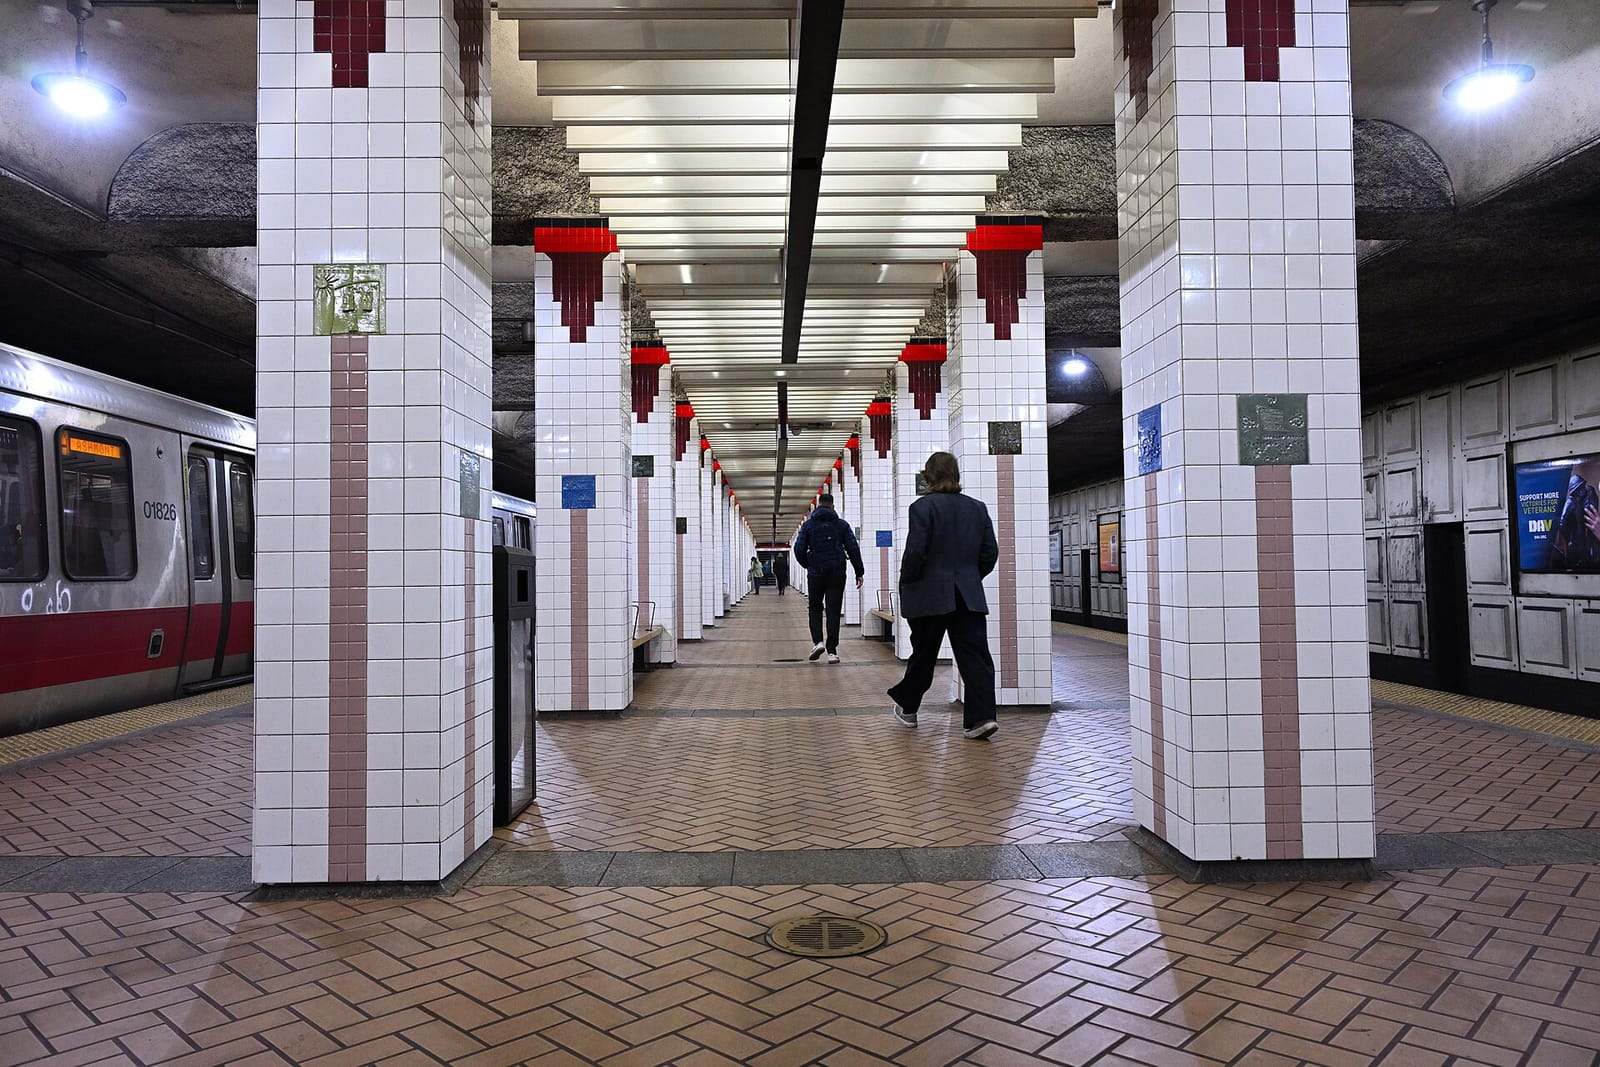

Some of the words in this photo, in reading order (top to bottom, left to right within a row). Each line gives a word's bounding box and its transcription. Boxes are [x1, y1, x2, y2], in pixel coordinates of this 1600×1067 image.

[1520, 494, 1542, 502] SUPPORT
[144, 501, 176, 520] 01826
[1523, 506, 1556, 514] VETERANS
[1528, 520, 1552, 532] DAV
